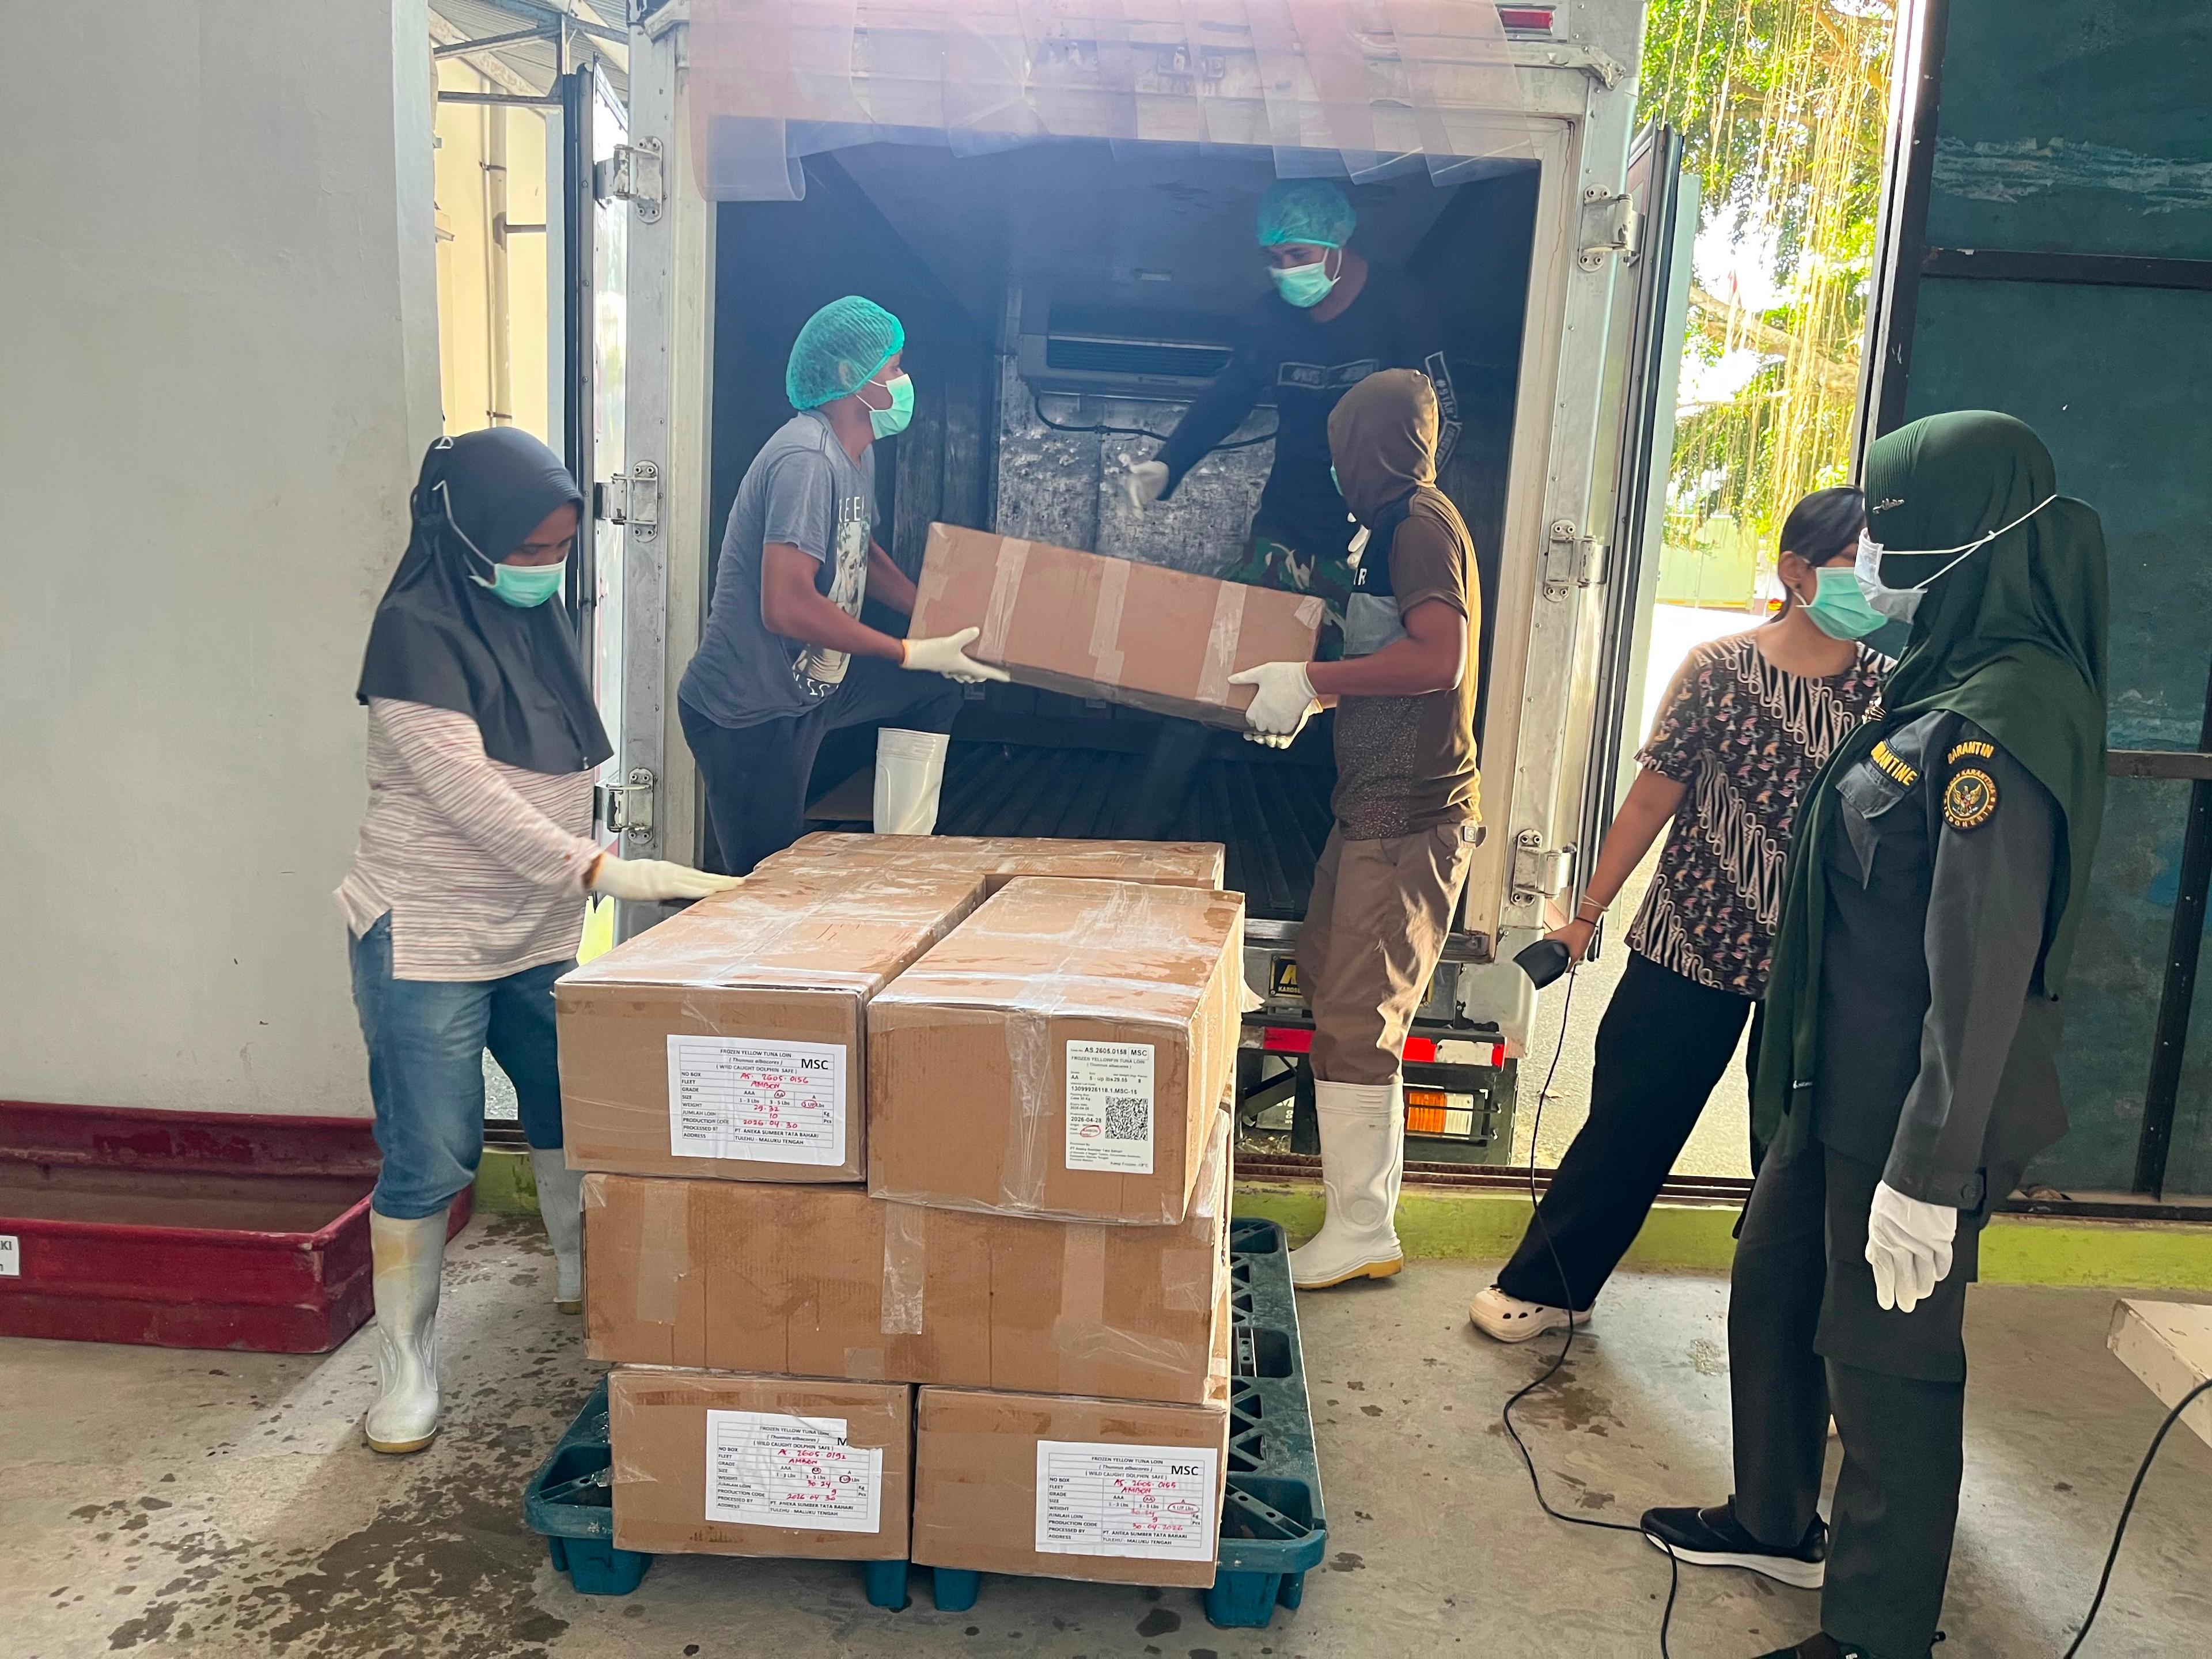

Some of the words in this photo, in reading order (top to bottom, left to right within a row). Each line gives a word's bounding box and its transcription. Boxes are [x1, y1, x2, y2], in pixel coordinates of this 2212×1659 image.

[801, 1059, 828, 1070] MSC
[751, 1081, 780, 1089] AMBON
[1171, 1465, 1199, 1475] MSC
